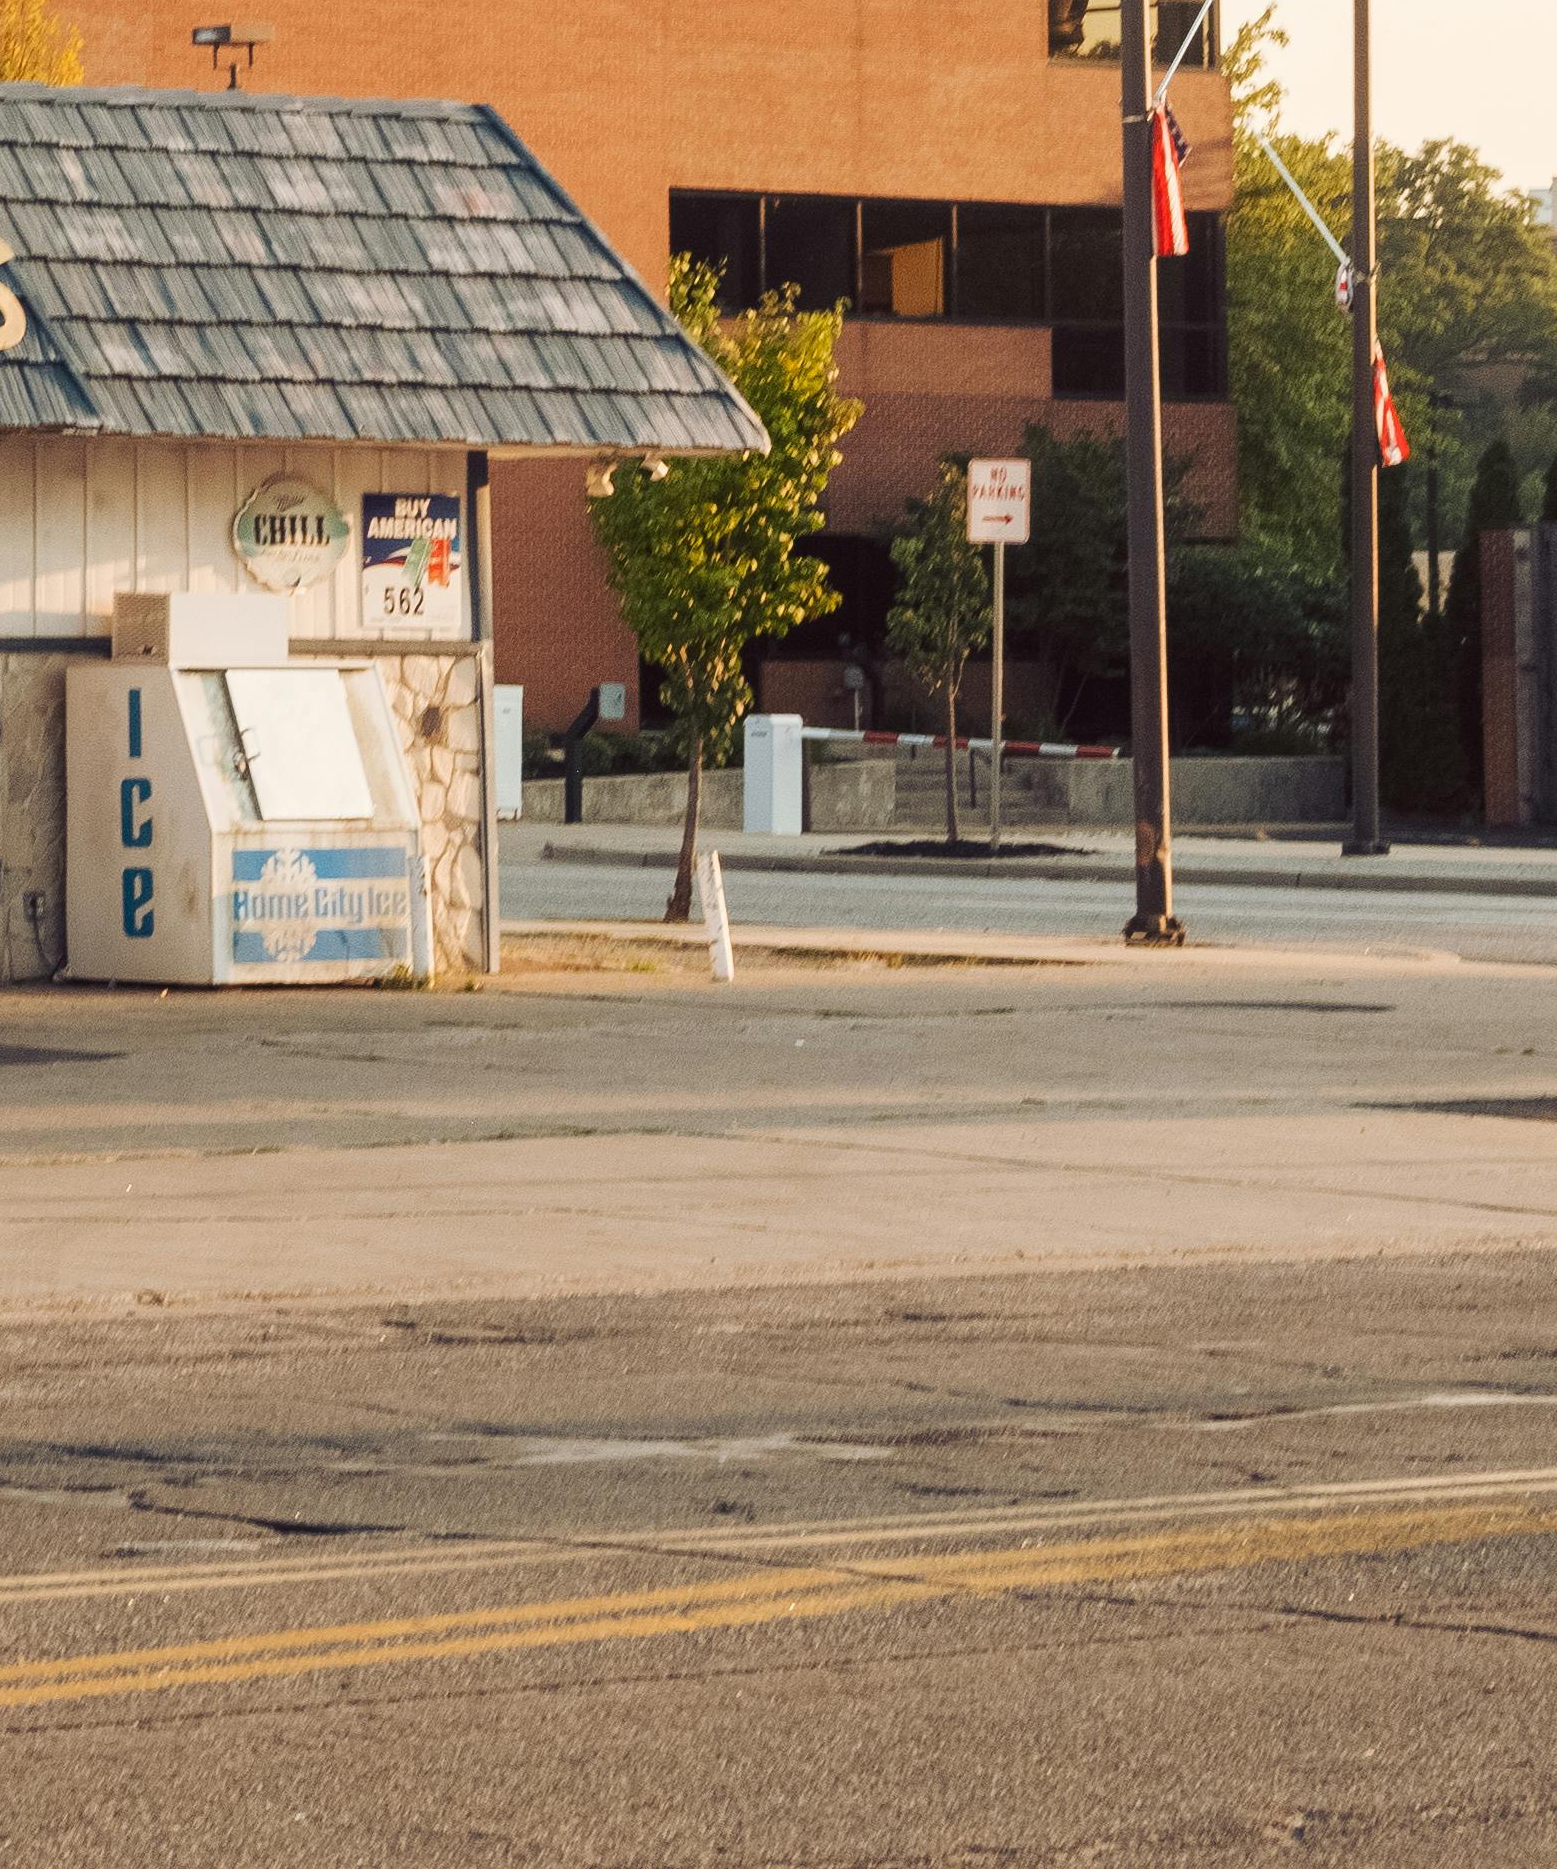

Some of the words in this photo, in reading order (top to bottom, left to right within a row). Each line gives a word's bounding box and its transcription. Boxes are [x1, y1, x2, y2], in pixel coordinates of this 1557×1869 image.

[990, 466, 1007, 483] NO
[972, 484, 1025, 501] PARKING
[395, 497, 431, 518] BUY
[253, 513, 330, 545] CHILL
[367, 517, 458, 540] AMERICAN
[383, 586, 425, 616] 562
[233, 888, 309, 921] Home
[314, 887, 364, 923] City
[367, 886, 406, 917] Ice
